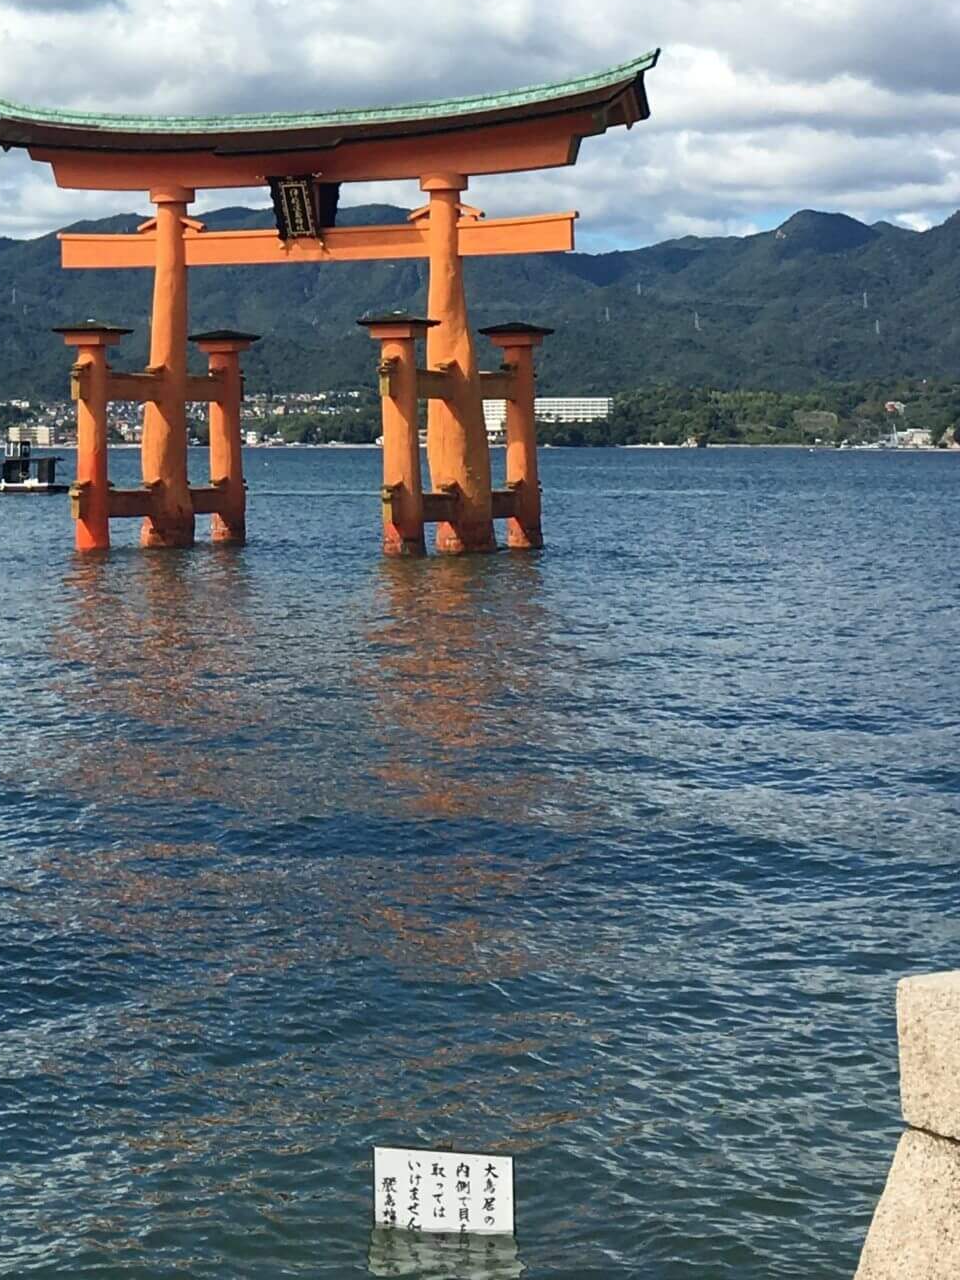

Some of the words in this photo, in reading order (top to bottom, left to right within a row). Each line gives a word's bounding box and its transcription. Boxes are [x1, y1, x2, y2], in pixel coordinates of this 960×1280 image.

[431, 1163, 446, 1218] 取っては
[482, 1163, 499, 1226] 大鳥居の
